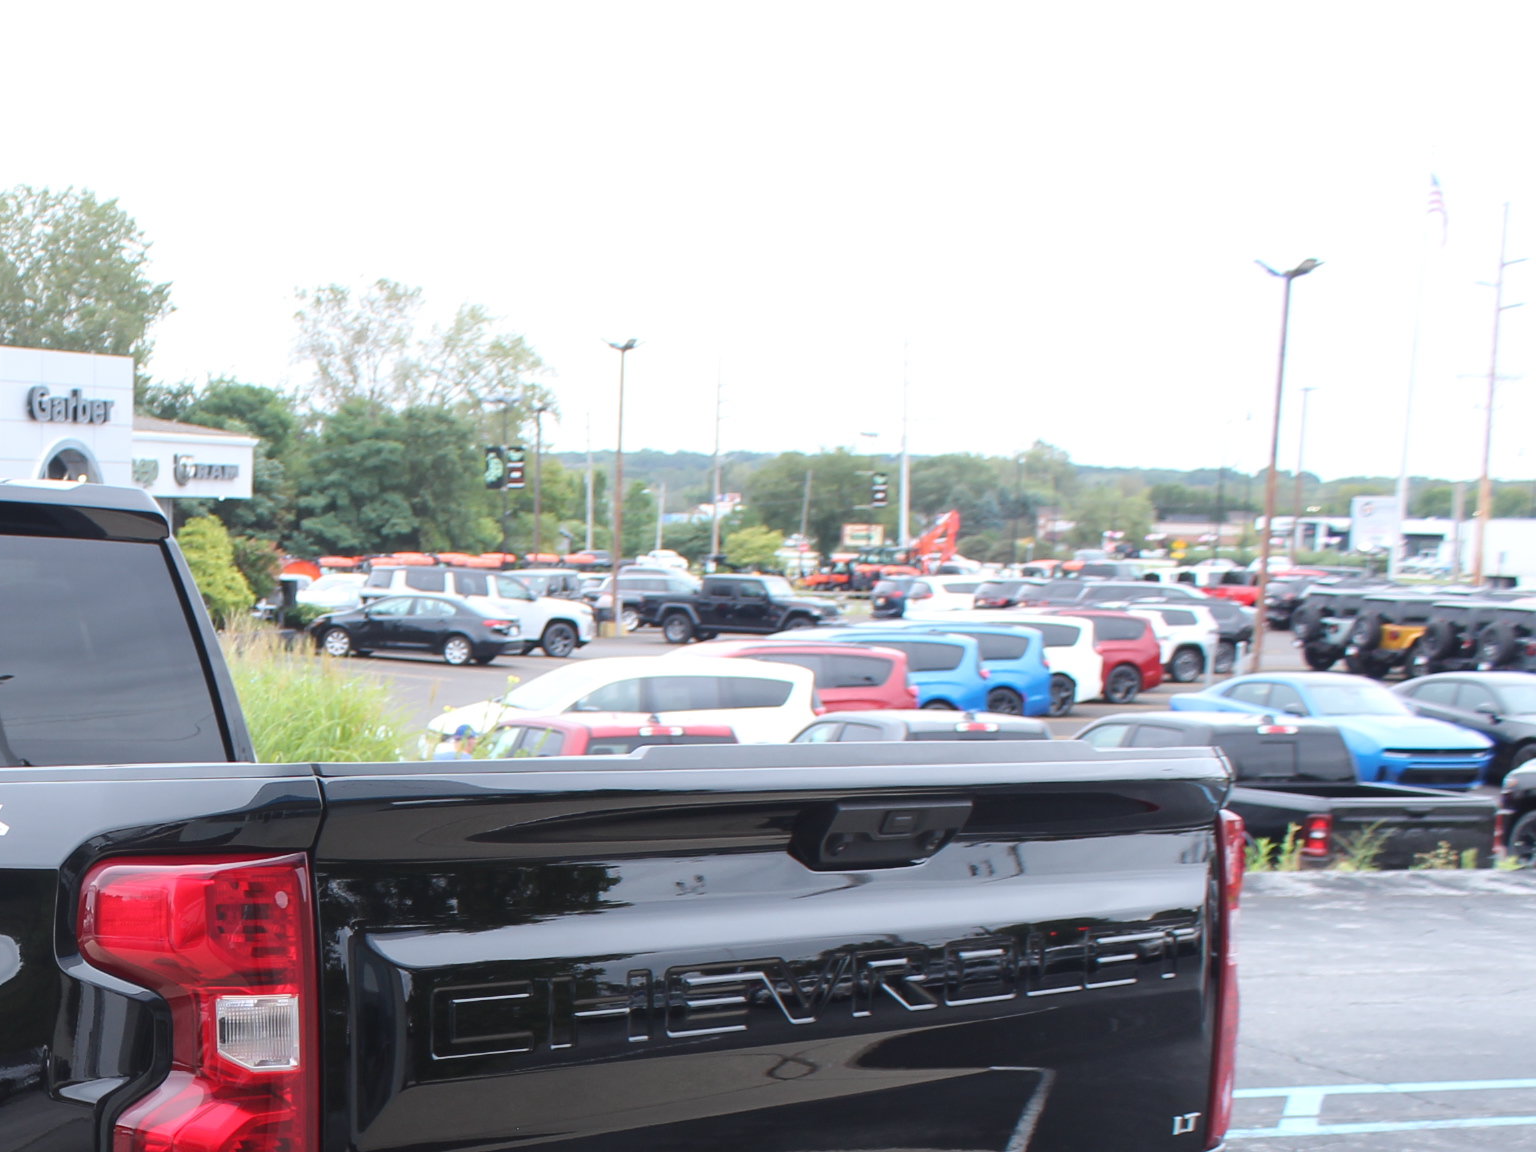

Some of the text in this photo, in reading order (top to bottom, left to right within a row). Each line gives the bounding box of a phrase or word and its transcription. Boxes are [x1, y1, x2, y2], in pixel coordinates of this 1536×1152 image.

[27, 386, 115, 424] Garber
[195, 463, 240, 481] RAM
[430, 918, 1200, 1060] CHEVROLET
[1172, 1112, 1201, 1135] LT
